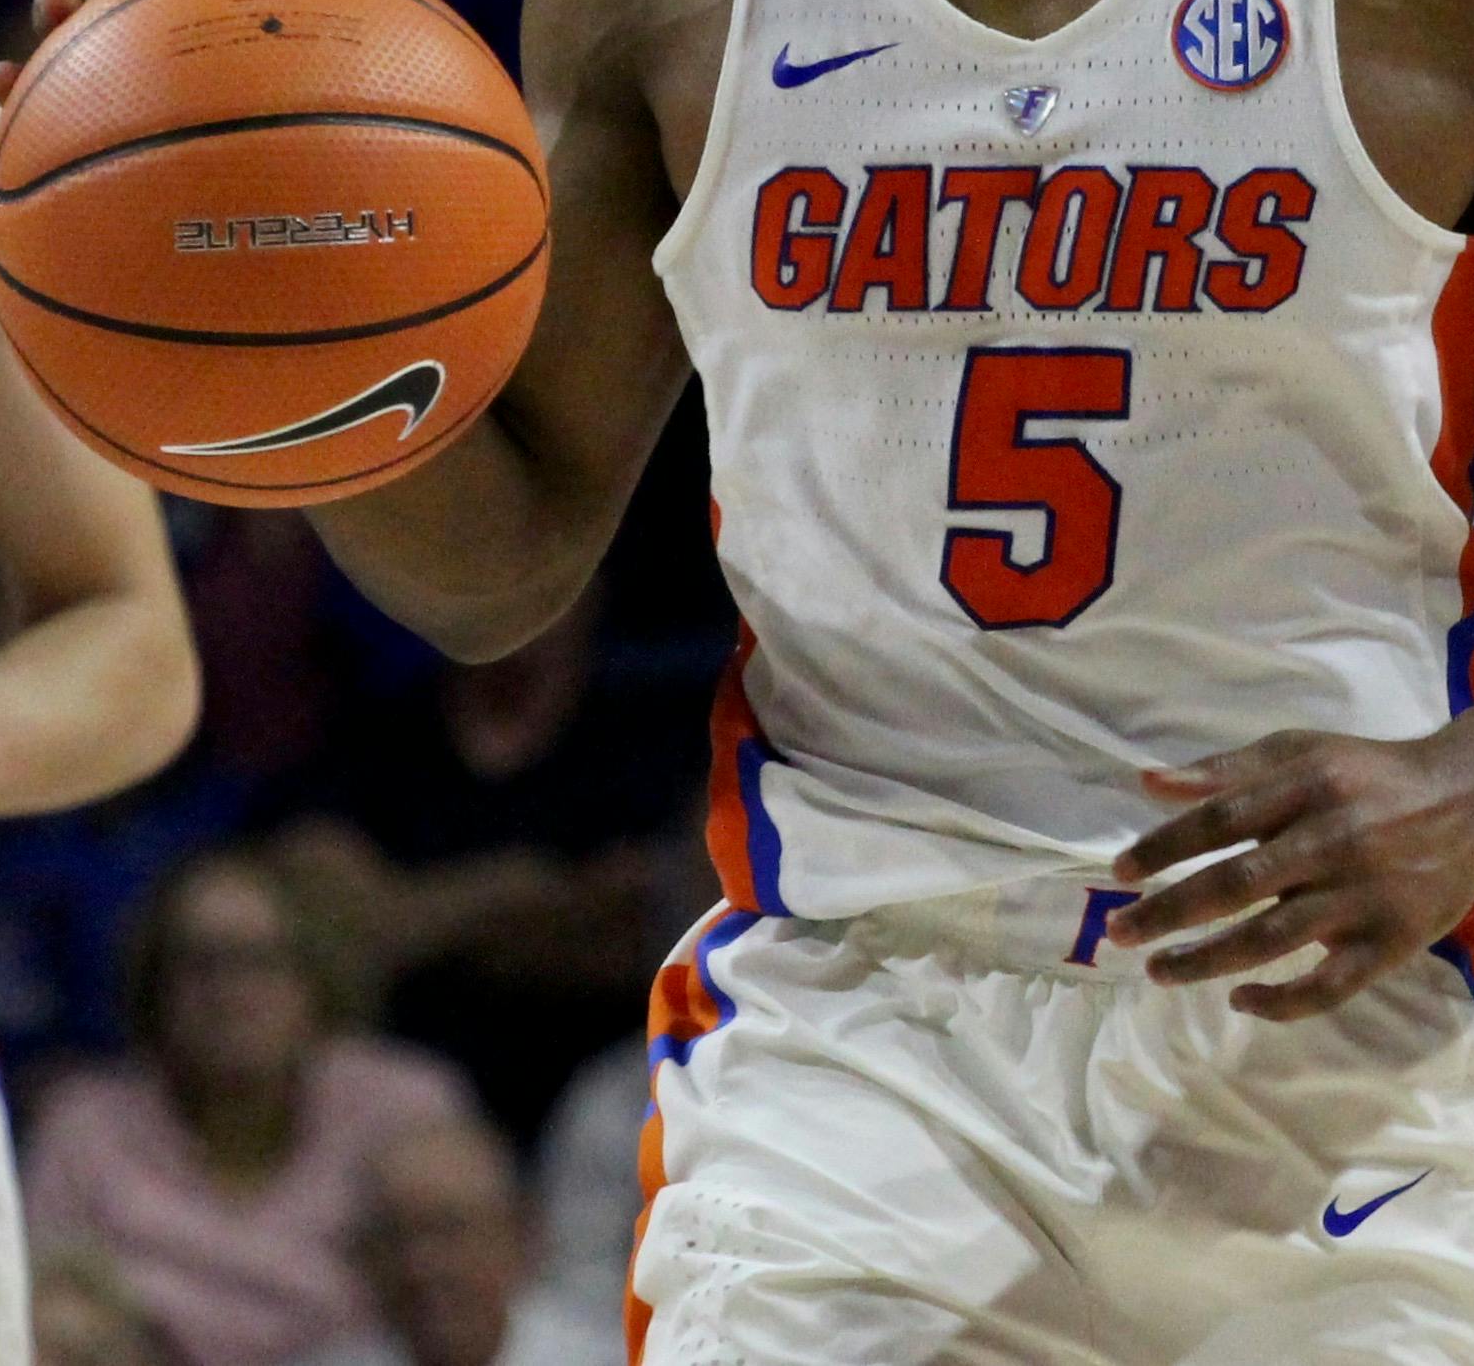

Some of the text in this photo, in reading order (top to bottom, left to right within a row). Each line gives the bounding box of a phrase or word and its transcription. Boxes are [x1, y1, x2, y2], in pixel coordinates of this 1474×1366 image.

[174, 207, 417, 253] HYPERELITE
[751, 164, 1317, 313] GATORS
[940, 346, 1132, 631] 5
